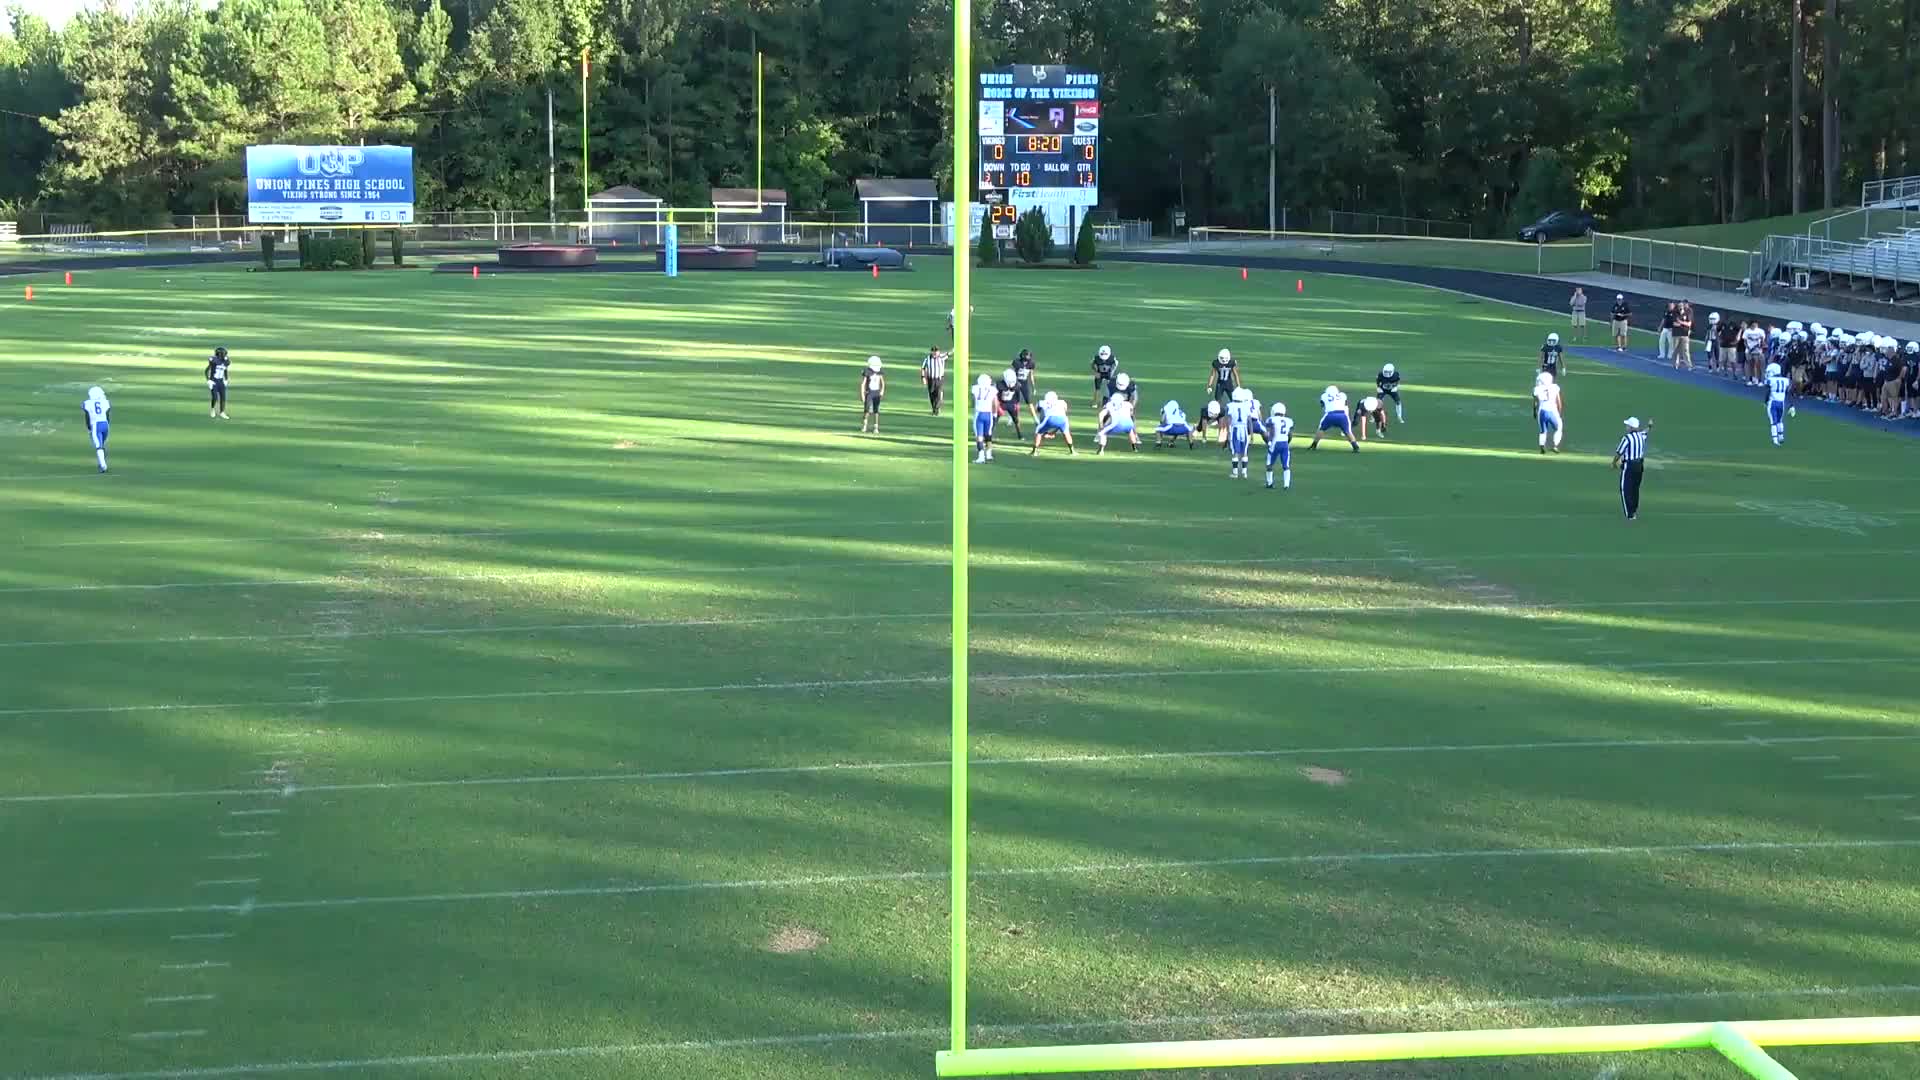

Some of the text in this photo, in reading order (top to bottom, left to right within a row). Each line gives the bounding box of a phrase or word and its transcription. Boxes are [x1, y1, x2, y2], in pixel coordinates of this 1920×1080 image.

[1014, 88, 1028, 98] OF
[1030, 88, 1050, 98] THE
[1028, 136, 1060, 151] 8:20
[1072, 137, 1096, 145] GUEST
[994, 145, 1003, 160] 0
[1085, 145, 1094, 160] 0
[983, 163, 1005, 171] DOWN
[1010, 163, 1031, 171] TO GO
[1044, 163, 1070, 172] BALL ON
[256, 179, 405, 190] UNION PINES HIGH SCHOOL
[1016, 171, 1030, 186] 10
[282, 190, 308, 199] VIKING
[311, 190, 338, 199] STRONG
[340, 190, 361, 199] SINCE
[992, 206, 1016, 224] 29
[1775, 379, 1785, 393] 11
[977, 387, 991, 400] 17
[94, 401, 102, 415] 6
[1280, 419, 1287, 434] 2
